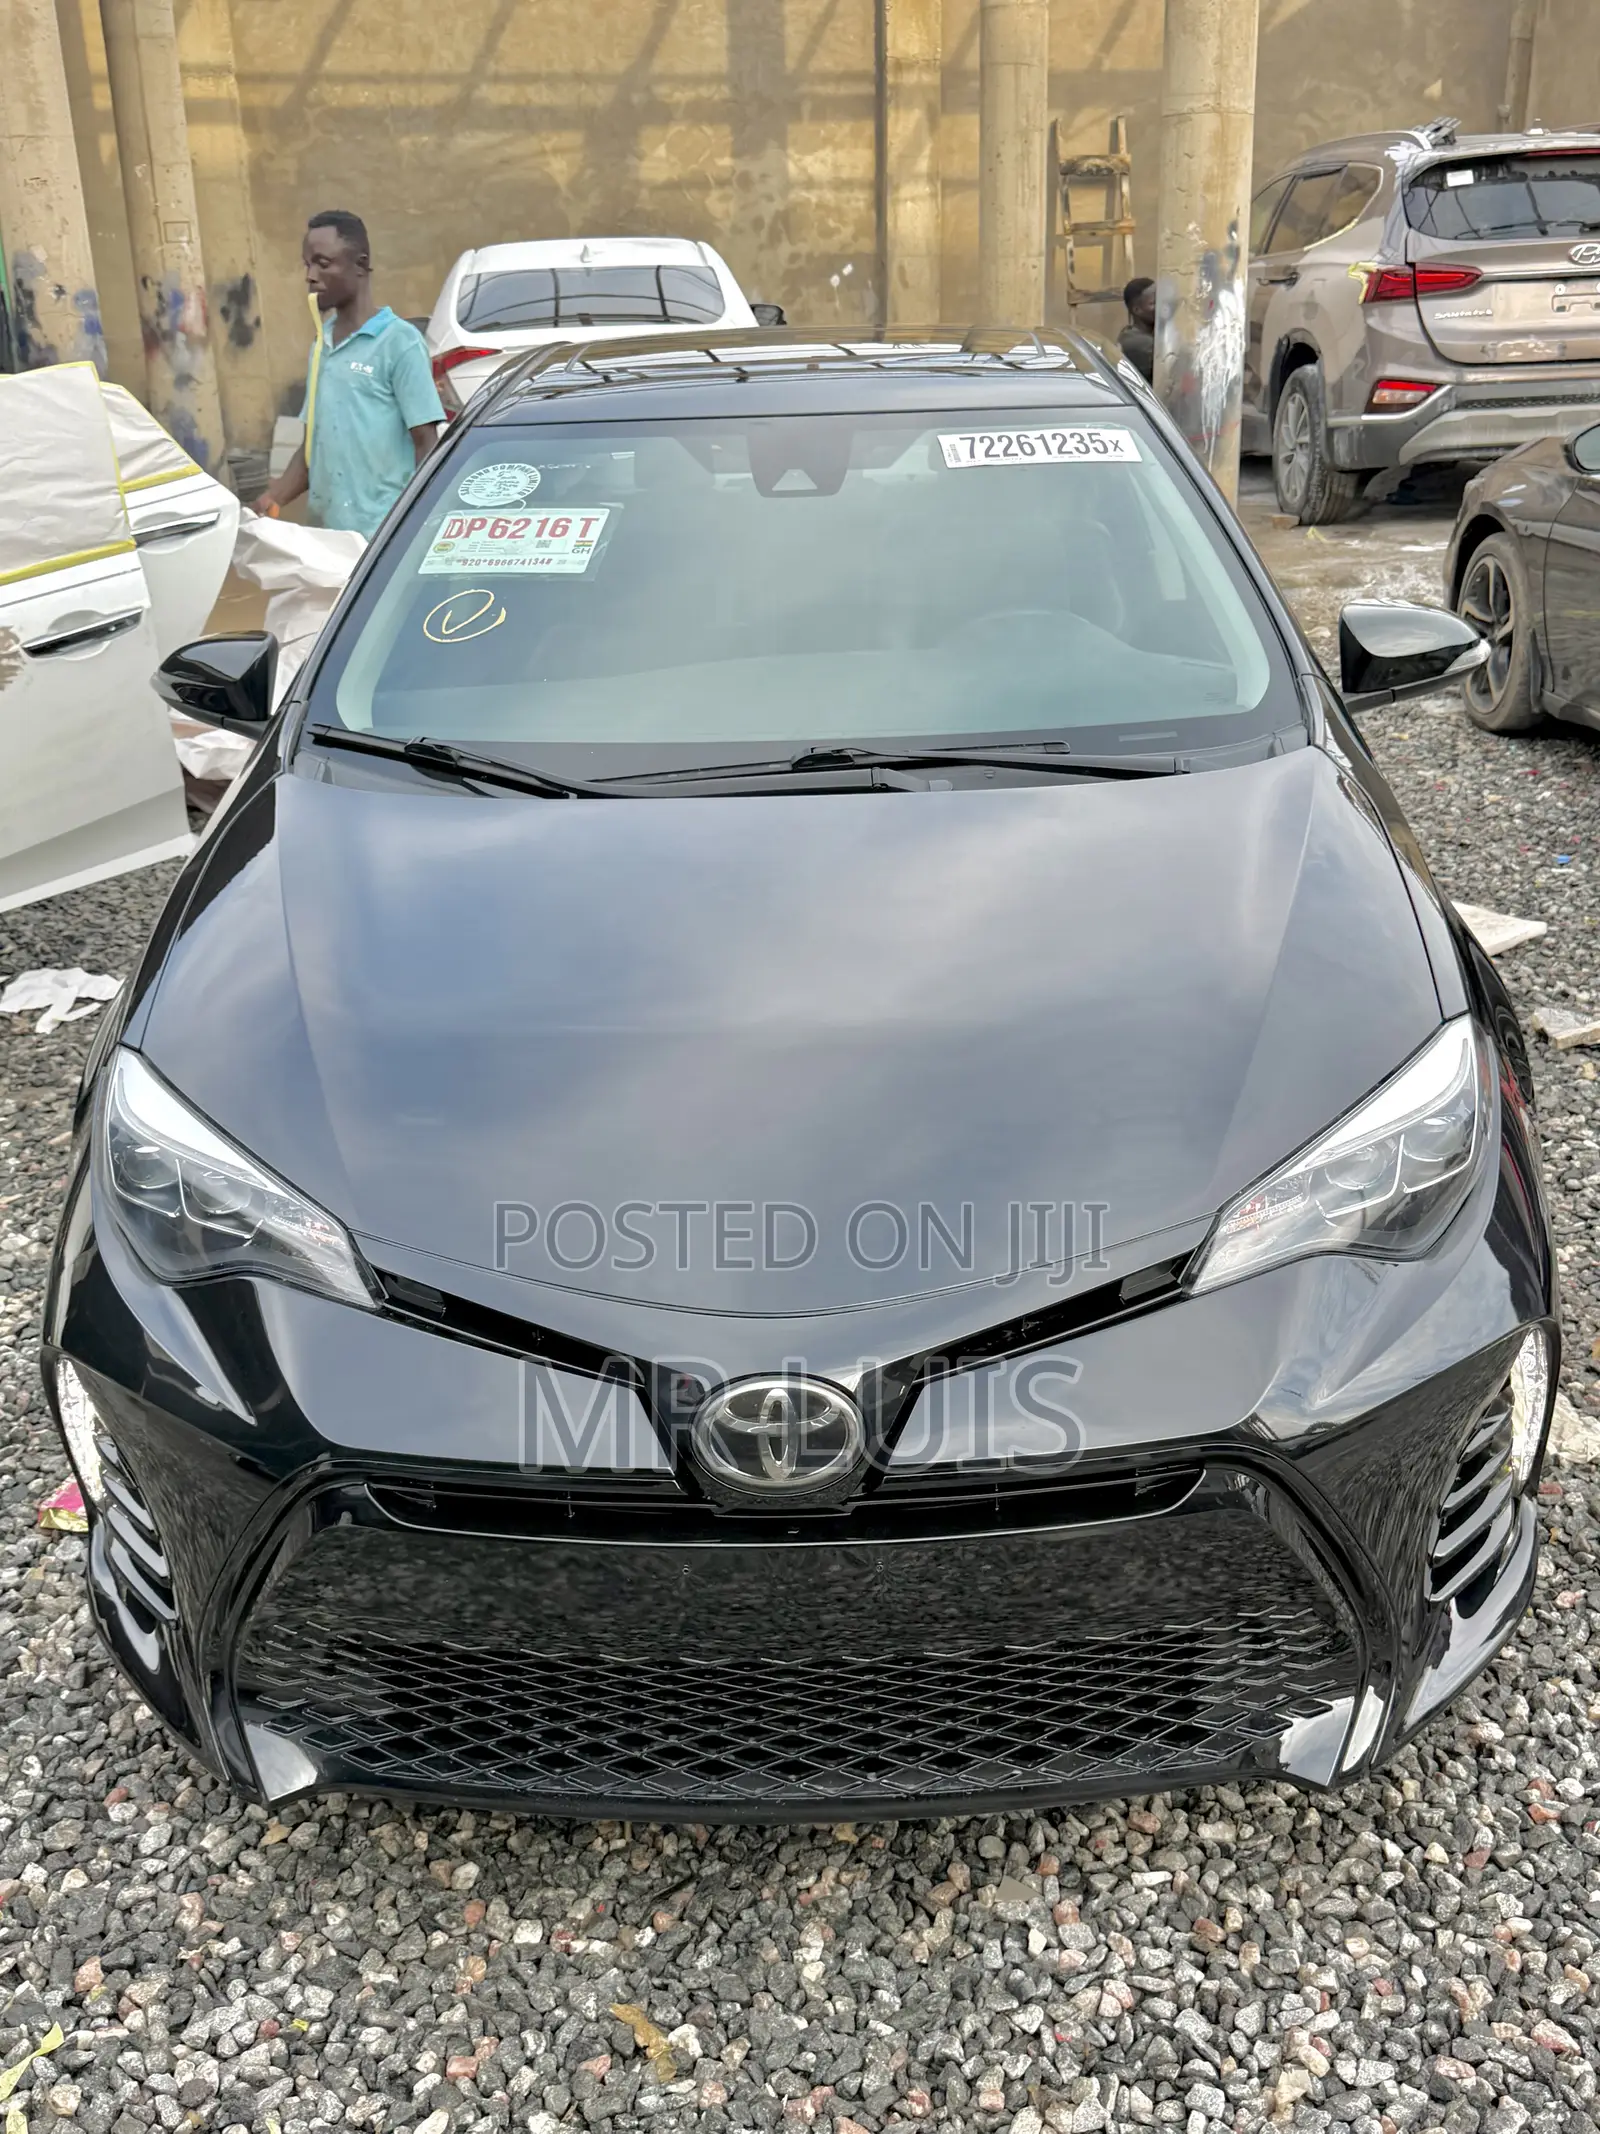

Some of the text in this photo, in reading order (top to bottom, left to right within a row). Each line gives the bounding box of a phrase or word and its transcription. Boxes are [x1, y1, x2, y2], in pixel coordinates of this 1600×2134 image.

[442, 516, 600, 540] DP 6216 T
[572, 547, 592, 555] GH
